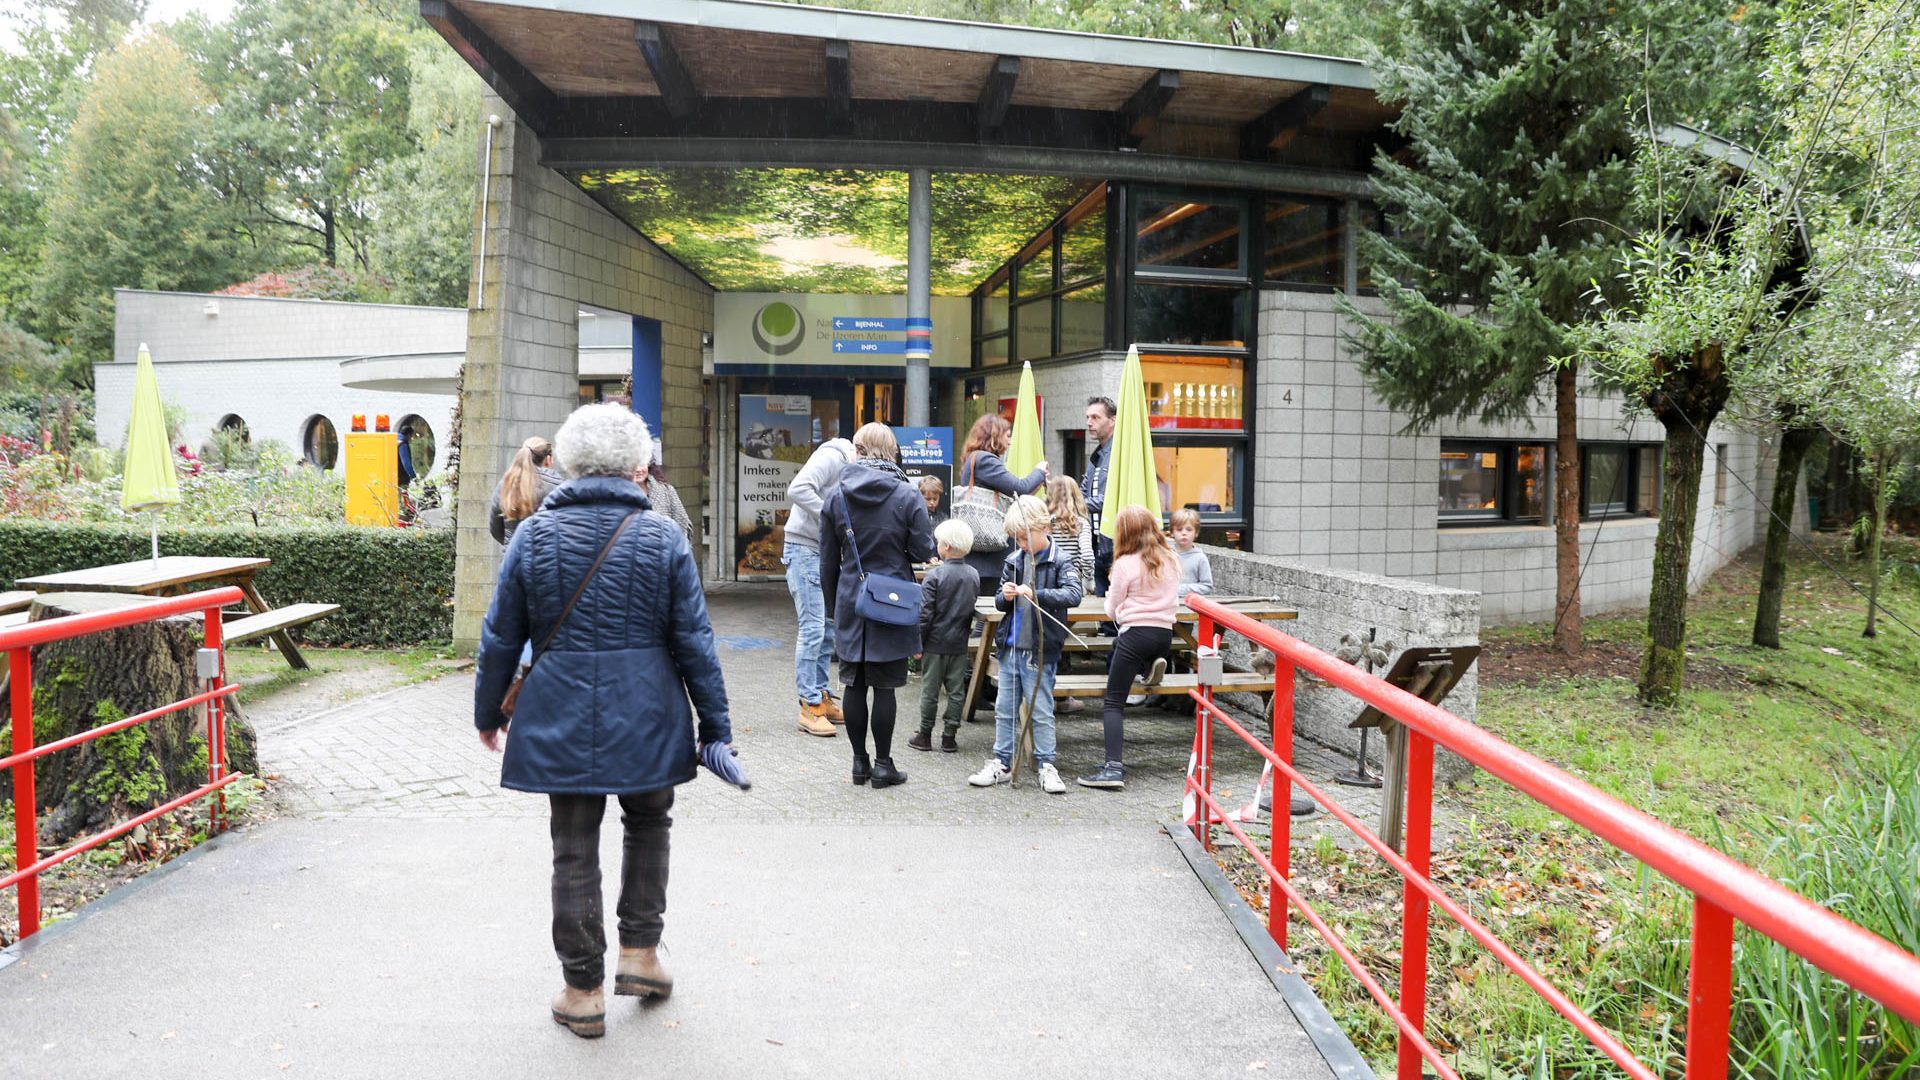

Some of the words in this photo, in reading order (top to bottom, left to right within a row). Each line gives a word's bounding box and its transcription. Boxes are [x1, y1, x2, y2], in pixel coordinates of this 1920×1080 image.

[816, 331, 831, 340] De
[866, 331, 888, 340] Man
[1282, 389, 1293, 405] 4
[743, 465, 781, 475] Imkers
[757, 480, 787, 489] maken
[743, 491, 785, 502] verschil
